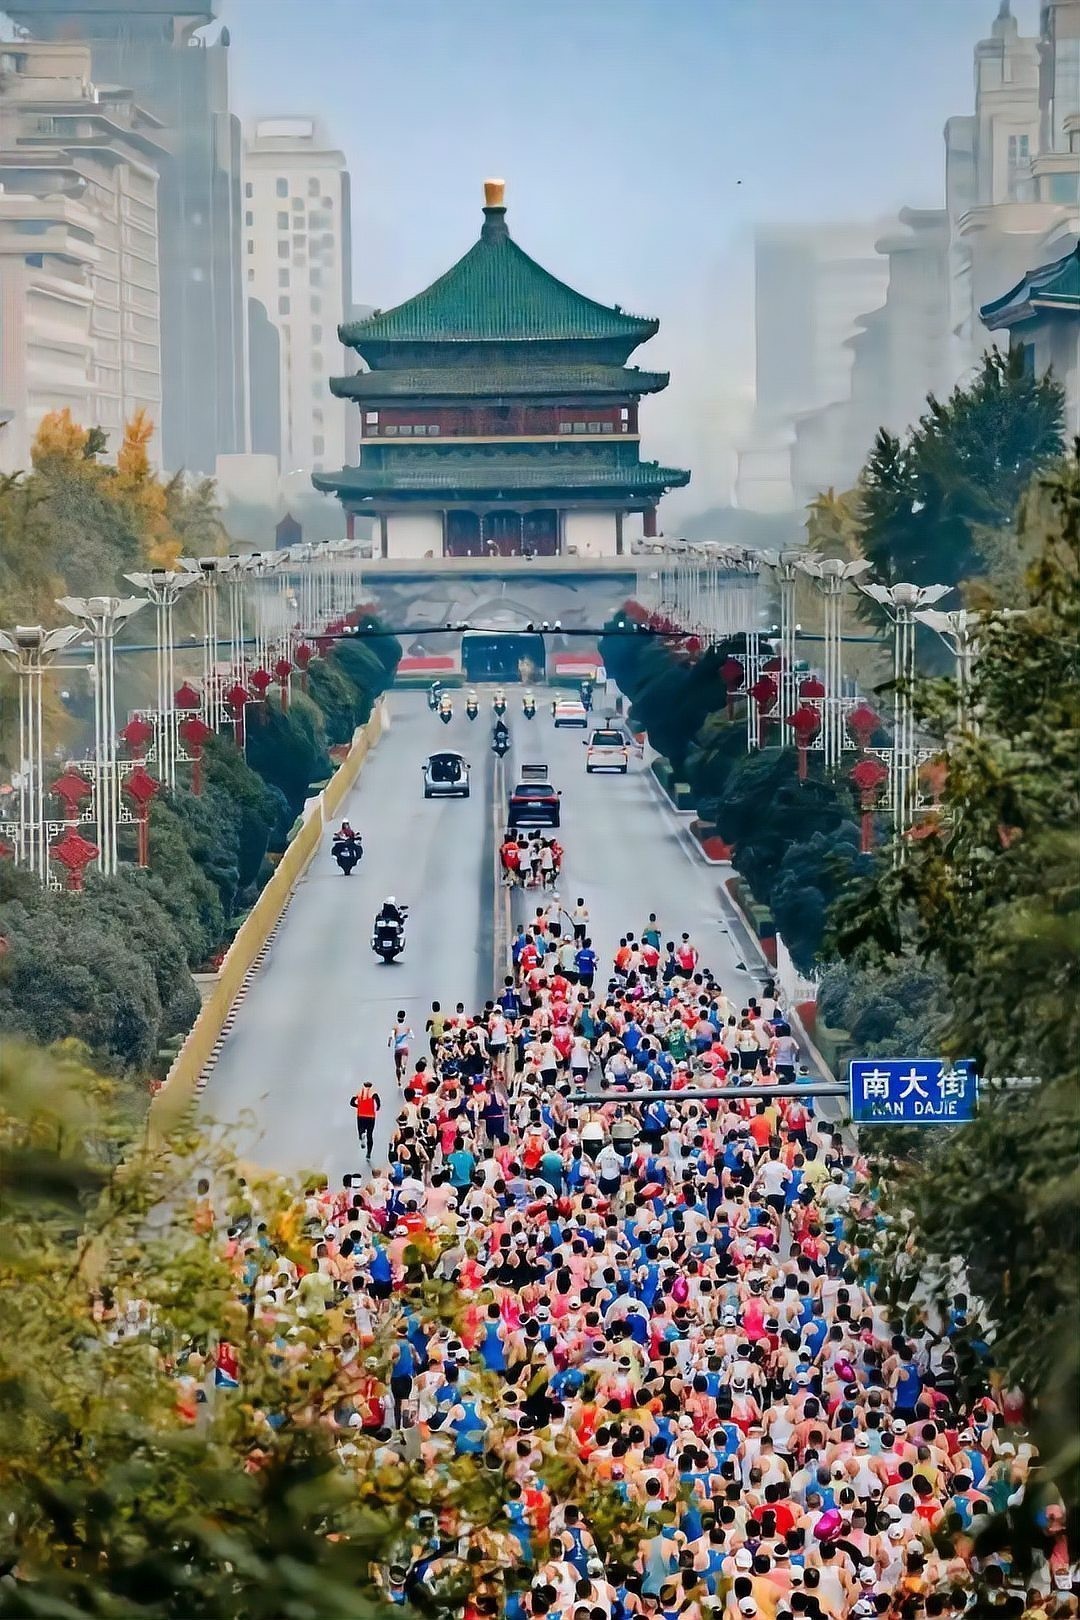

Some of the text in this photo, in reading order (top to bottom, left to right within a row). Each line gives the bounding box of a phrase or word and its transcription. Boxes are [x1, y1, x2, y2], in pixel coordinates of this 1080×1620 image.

[861, 1068, 968, 1099] 南大街
[914, 1100, 958, 1116] DAJIE
